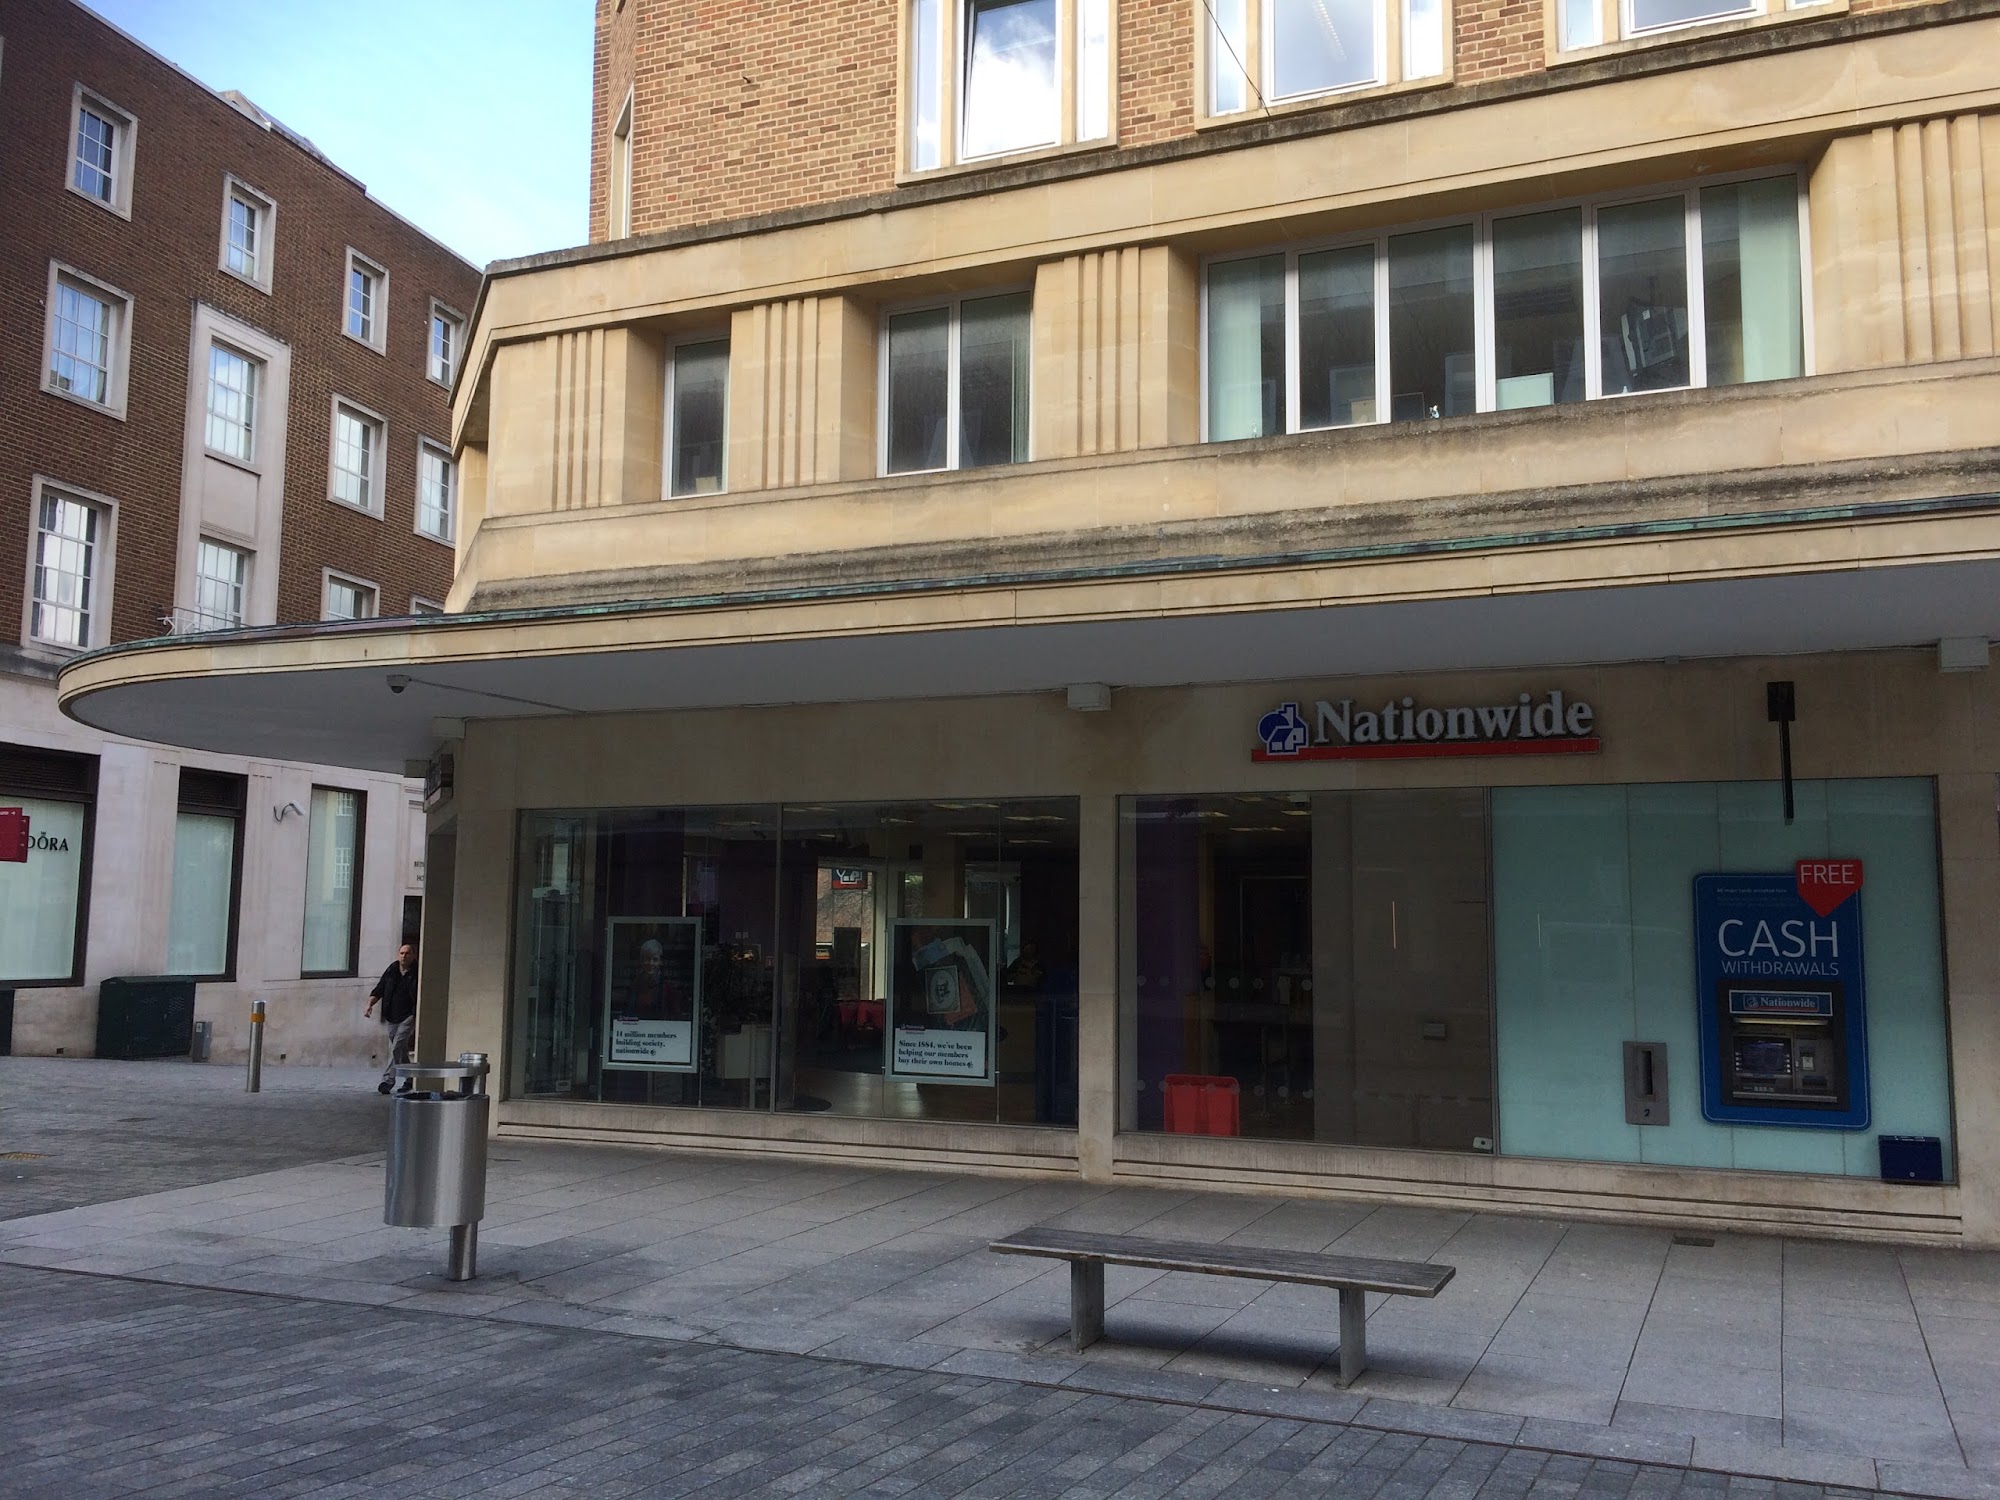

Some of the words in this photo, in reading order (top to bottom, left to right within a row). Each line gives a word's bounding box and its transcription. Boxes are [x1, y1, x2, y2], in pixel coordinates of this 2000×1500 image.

[1313, 690, 1595, 744] Nationwide
[28, 832, 69, 852] DORA
[1800, 863, 1856, 885] FREE
[1718, 918, 1839, 958] CASH
[1721, 960, 1839, 976] WITHDRAWALS
[1760, 997, 1816, 1008] Nationwide
[624, 1030, 646, 1038] million
[647, 1031, 677, 1039] members
[615, 1038, 641, 1047] building
[642, 1039, 666, 1048] society,
[898, 1039, 917, 1048] Since
[917, 1040, 935, 1049] 1884,
[936, 1041, 955, 1050] we've
[956, 1042, 972, 1051] been
[615, 1047, 650, 1055] nationwide
[898, 1048, 923, 1058] helping
[937, 1050, 969, 1059] members
[897, 1056, 910, 1066] buy
[911, 1057, 928, 1065] their
[944, 1059, 966, 1068] homes
